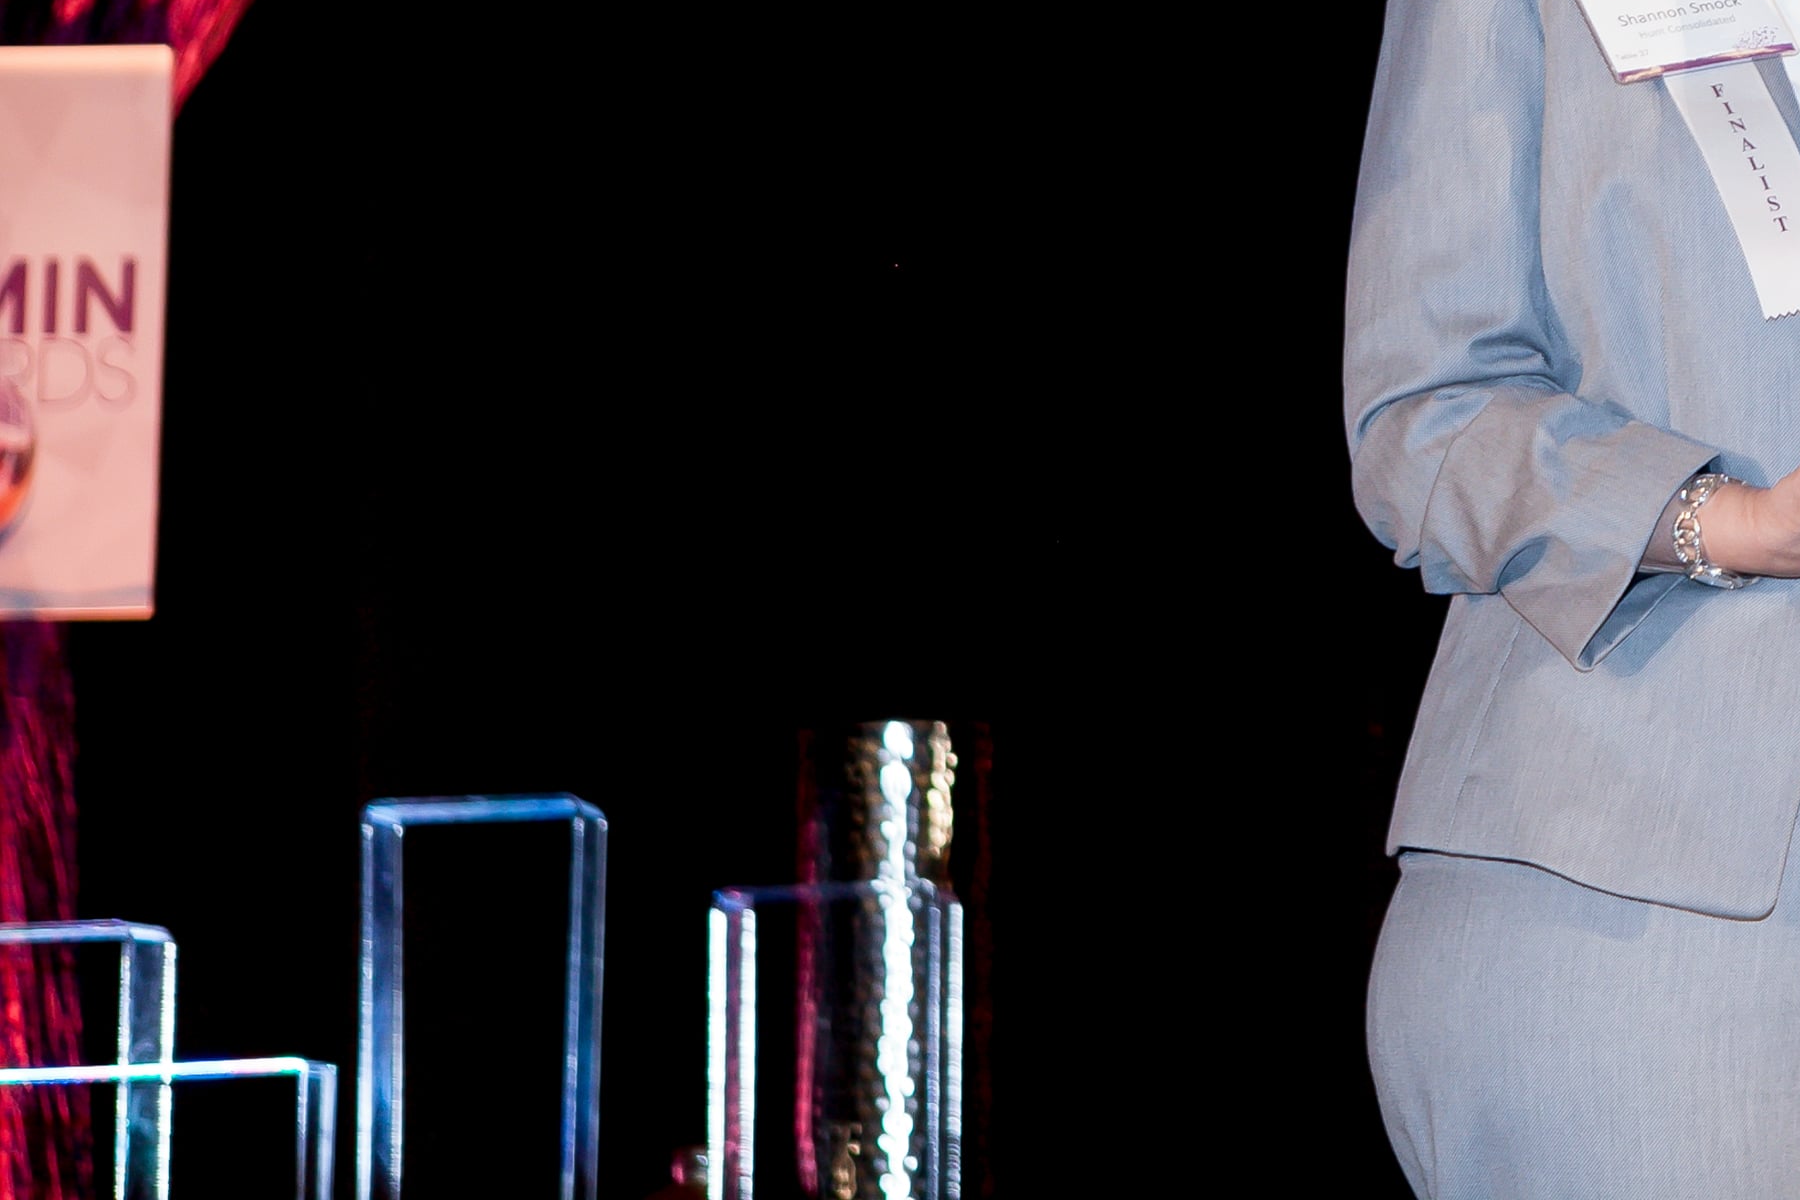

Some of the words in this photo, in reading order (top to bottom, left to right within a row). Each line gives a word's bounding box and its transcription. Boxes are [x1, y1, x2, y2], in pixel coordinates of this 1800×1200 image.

[1617, 5, 1687, 27] Shannon
[1667, 14, 1737, 34] Consolidated
[1711, 83, 1790, 233] FINALIST
